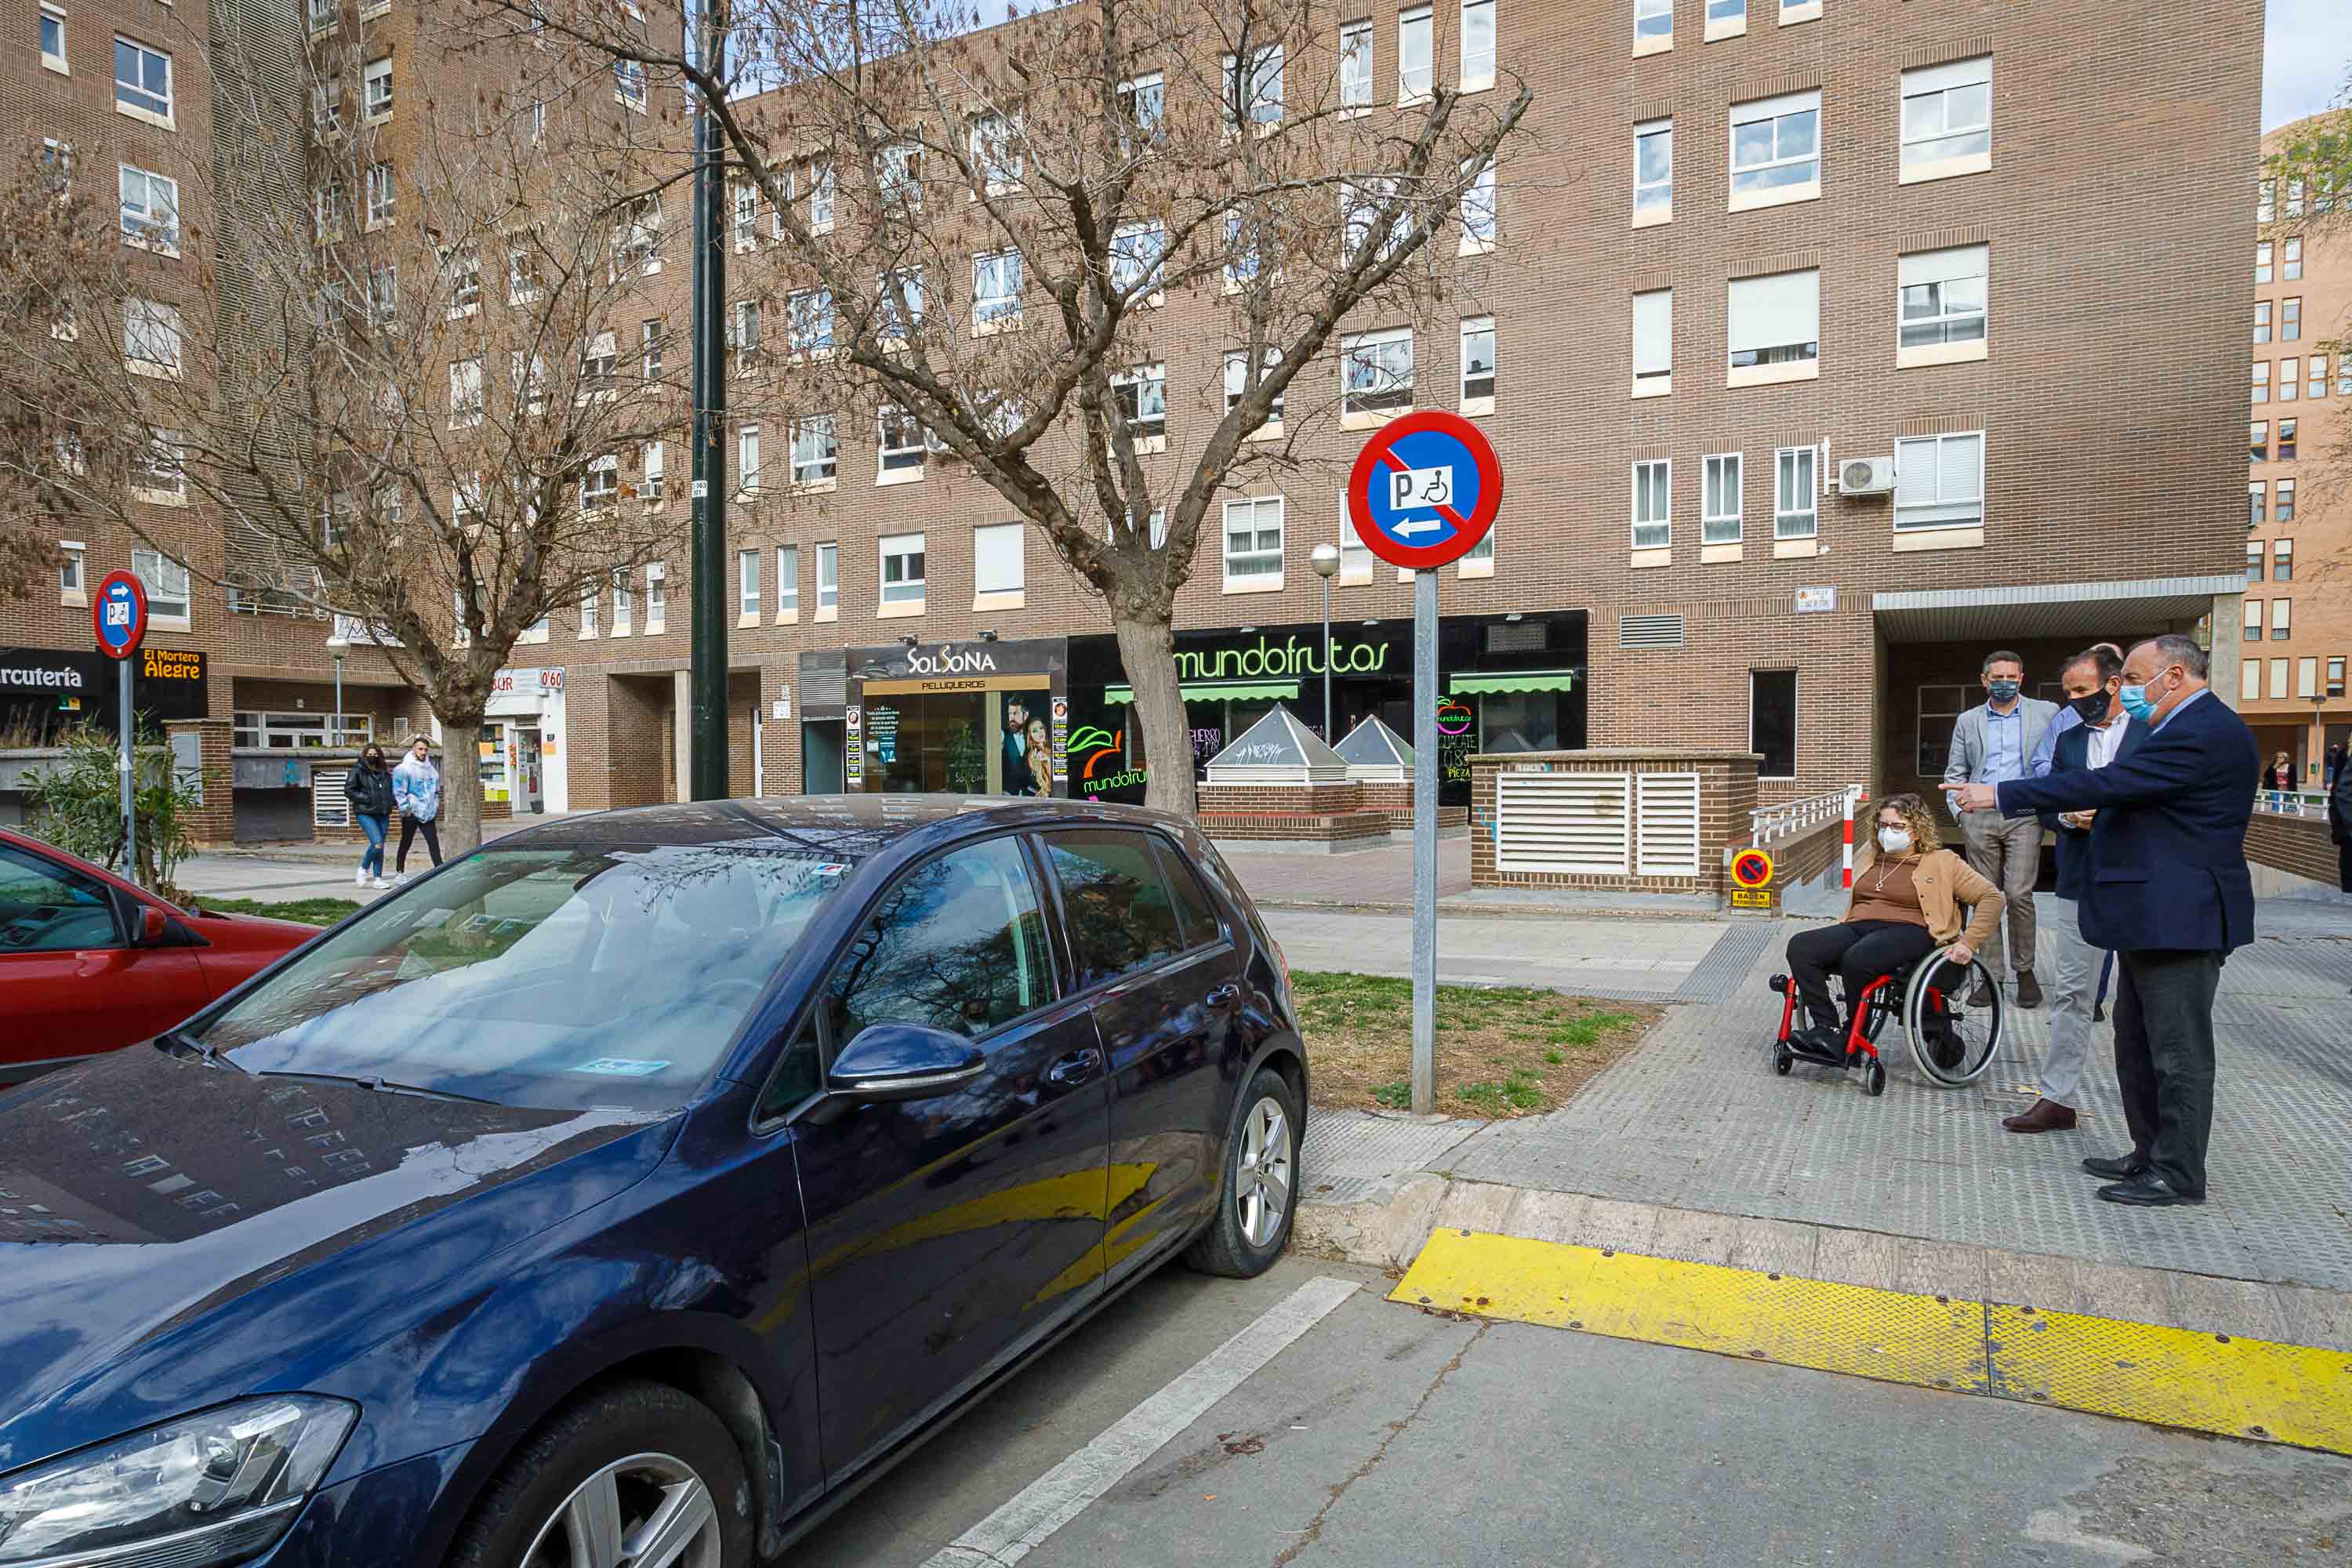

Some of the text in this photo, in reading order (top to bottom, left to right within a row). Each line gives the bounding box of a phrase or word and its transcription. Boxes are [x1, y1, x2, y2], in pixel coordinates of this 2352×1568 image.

[1396, 474, 1413, 508] P
[109, 604, 115, 624] P
[144, 649, 200, 663] El Mortero
[907, 644, 996, 673] SOLSONA
[1172, 635, 1388, 678] mundofrutas
[0, 667, 82, 688] rcutería
[144, 661, 200, 679] Alegre
[542, 671, 562, 687] 0'60
[922, 680, 985, 691] PELUQUEROS
[1083, 771, 1149, 793] mundofru
